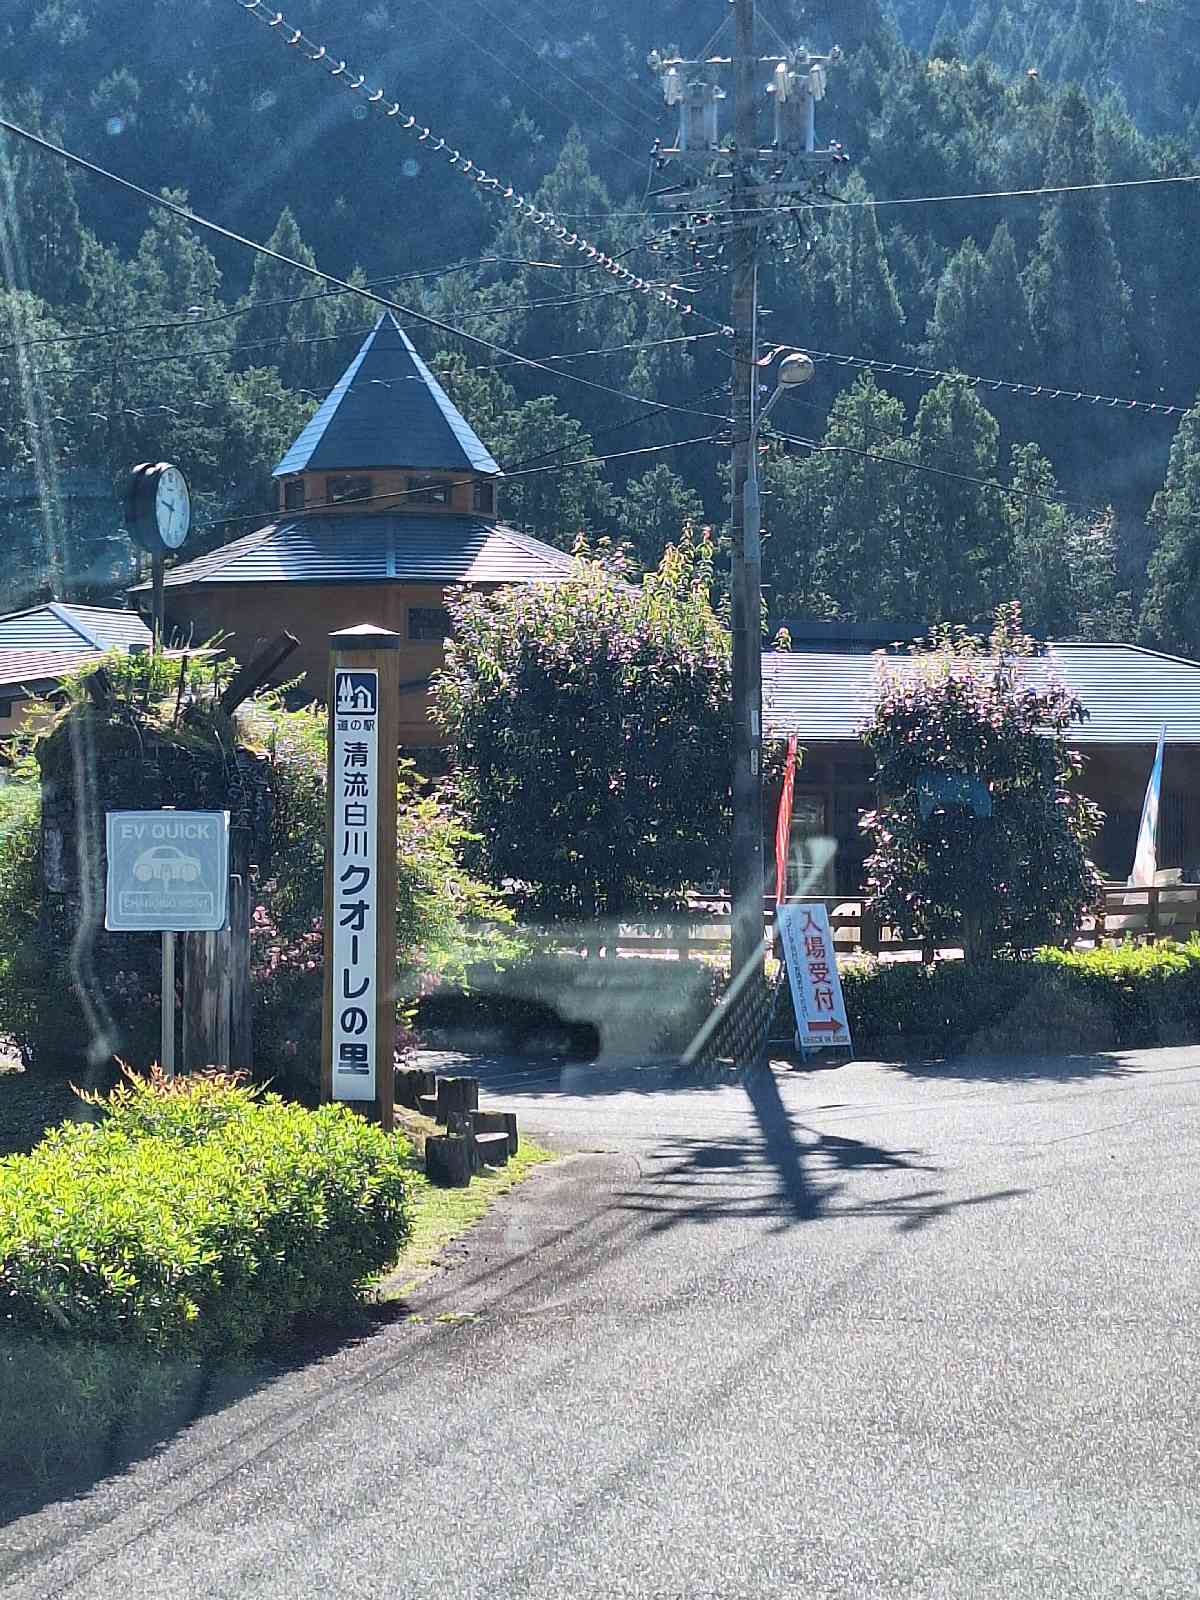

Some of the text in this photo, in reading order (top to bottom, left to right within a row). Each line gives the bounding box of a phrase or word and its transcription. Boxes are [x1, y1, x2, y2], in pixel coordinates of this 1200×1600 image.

[336, 719, 375, 732] 道の駅
[121, 823, 210, 839] EV QUICK
[338, 741, 370, 1075] 清流白川クオーレの里
[801, 911, 834, 1012] 入場受付
